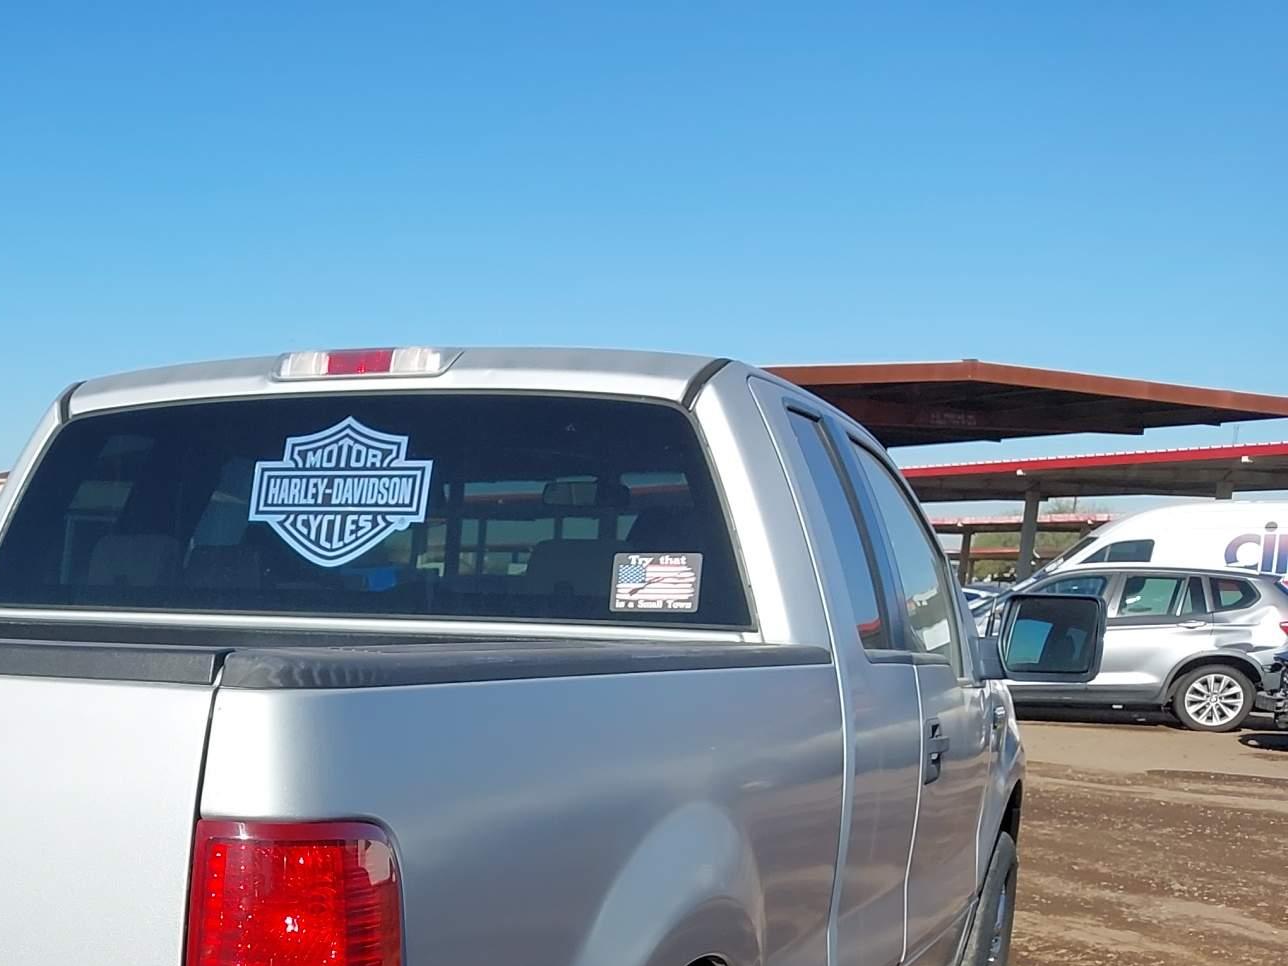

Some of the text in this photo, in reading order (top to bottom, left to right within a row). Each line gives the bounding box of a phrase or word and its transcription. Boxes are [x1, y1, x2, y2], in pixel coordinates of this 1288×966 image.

[305, 438, 382, 468] MOTOR
[267, 477, 413, 504] HARLEY-DAVIDSON
[296, 514, 373, 550] CYCLES
[628, 555, 687, 568] Try that
[637, 599, 664, 608] Small
[666, 599, 692, 609] Town
